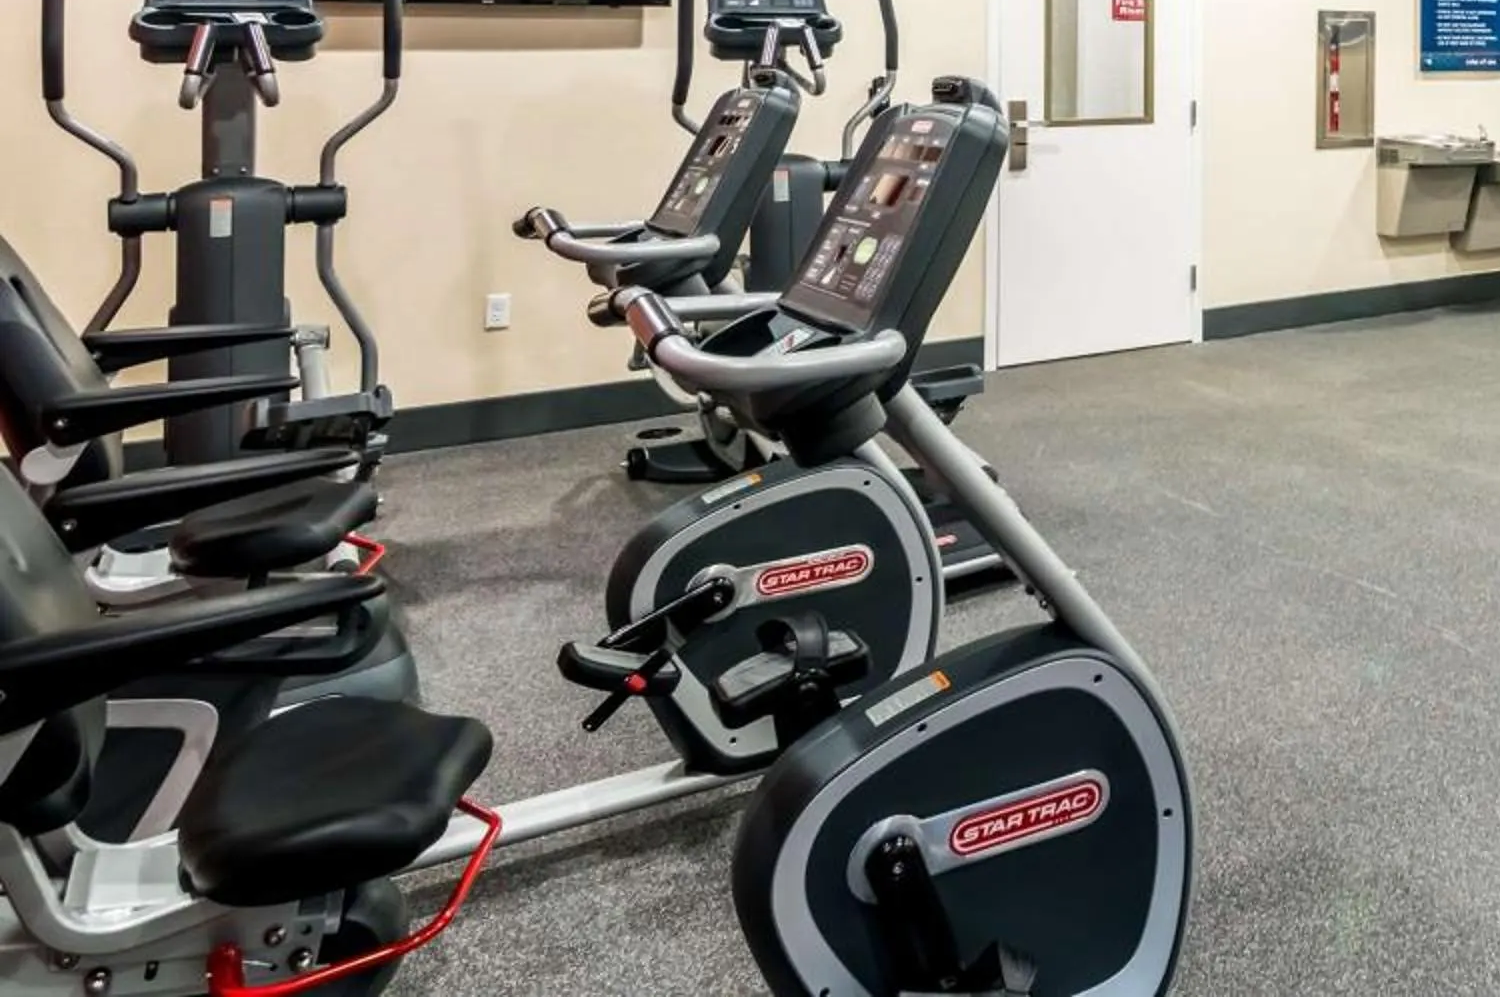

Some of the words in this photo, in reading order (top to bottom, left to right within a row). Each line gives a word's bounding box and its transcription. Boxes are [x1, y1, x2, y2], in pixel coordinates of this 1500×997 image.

[767, 571, 810, 586] STAR
[814, 559, 859, 576] TRAC
[962, 812, 1024, 842] STAR
[1028, 792, 1090, 822] TRAC
